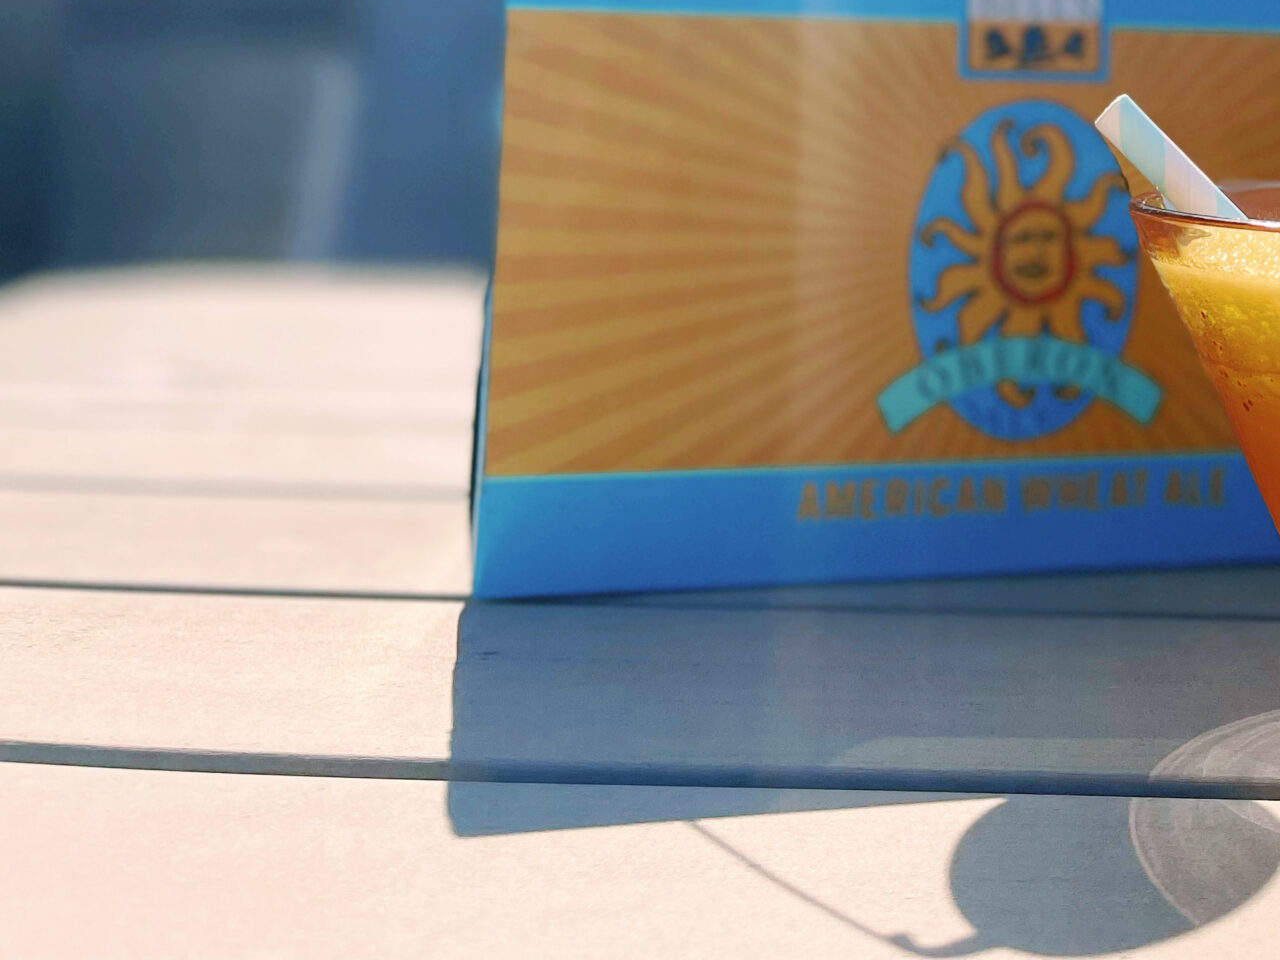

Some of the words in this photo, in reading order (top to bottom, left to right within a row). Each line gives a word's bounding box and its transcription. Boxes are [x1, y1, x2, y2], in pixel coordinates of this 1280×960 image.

[917, 340, 1119, 398] OBERON
[798, 477, 1005, 519] AMERICAN
[1021, 471, 1147, 510] WHEAT
[1165, 468, 1226, 506] ALE
